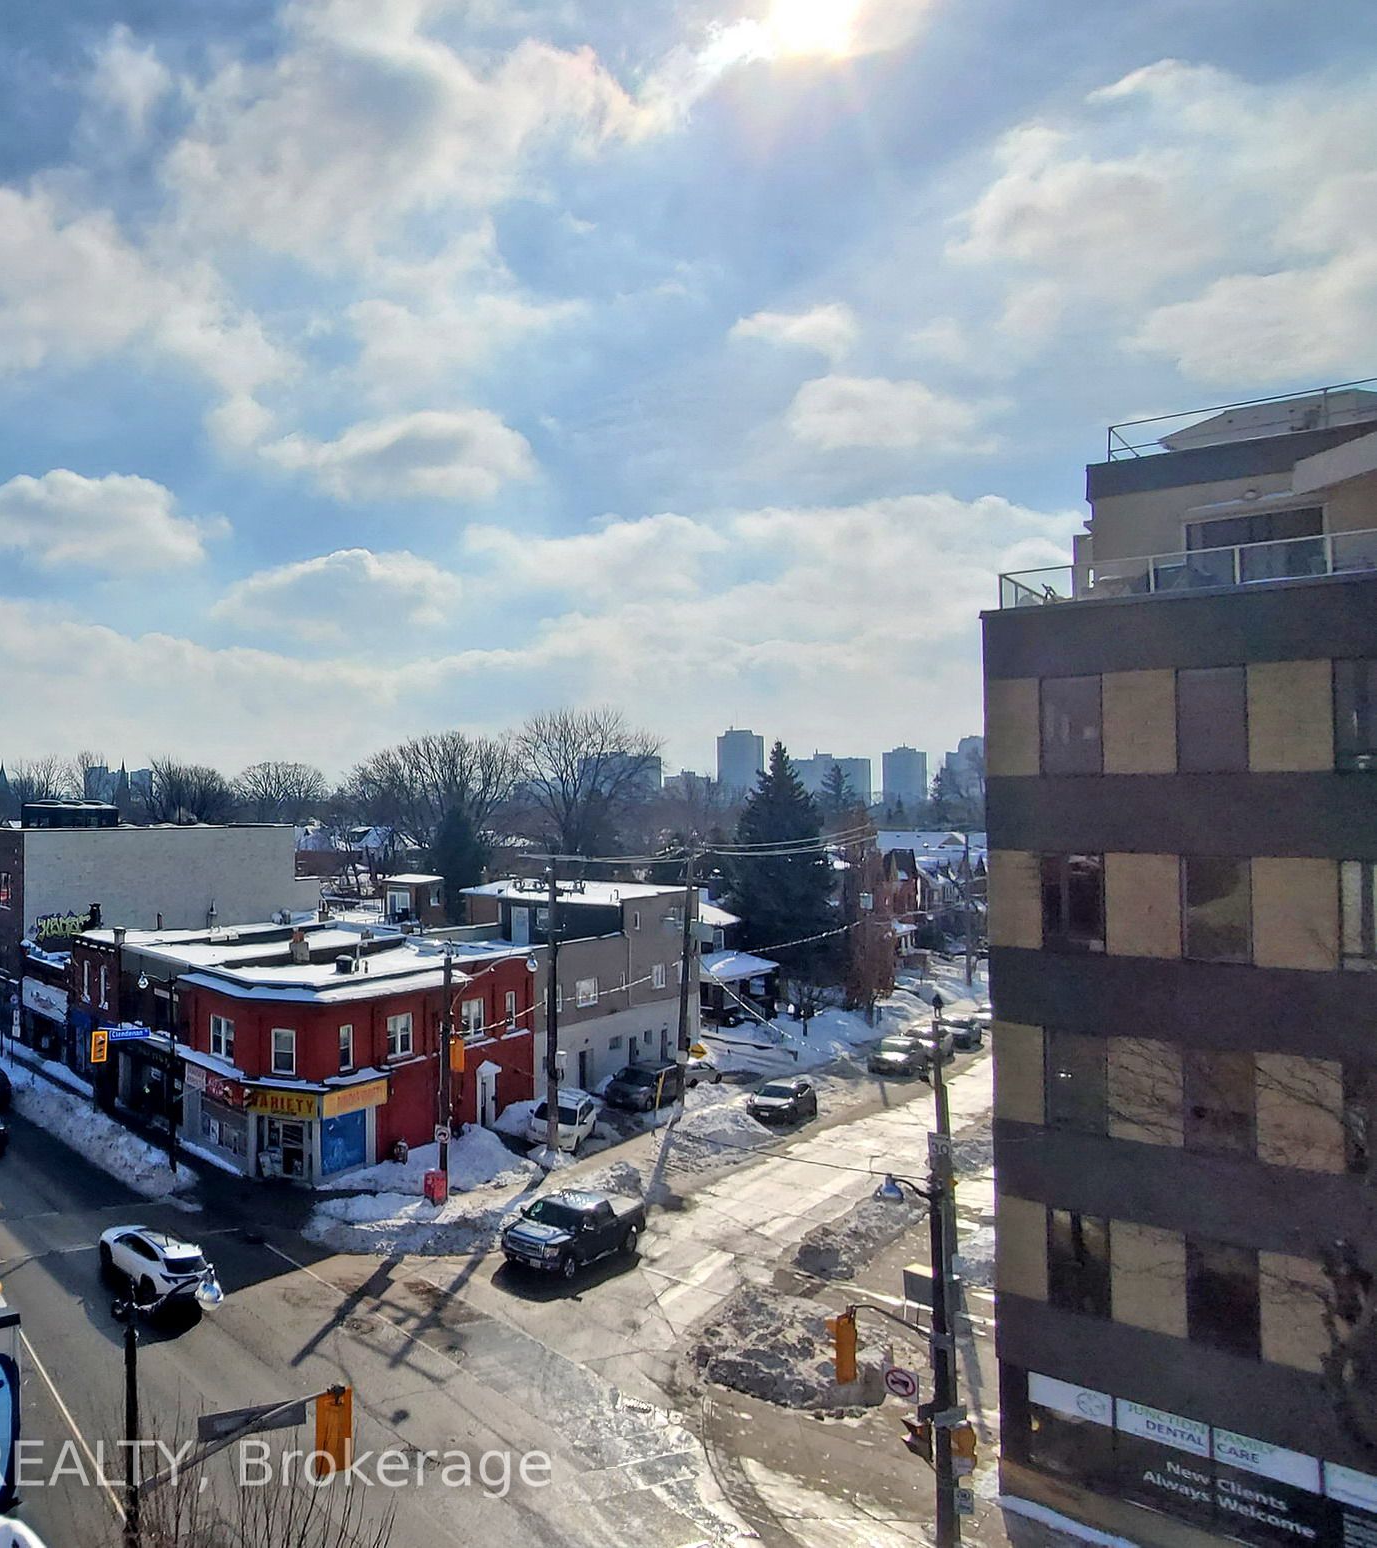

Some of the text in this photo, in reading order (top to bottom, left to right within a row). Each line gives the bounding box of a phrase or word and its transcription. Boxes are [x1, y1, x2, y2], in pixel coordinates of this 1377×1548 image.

[1128, 1404, 1205, 1434] JUNCTION
[1216, 1428, 1277, 1454] FAMILY
[1146, 1420, 1204, 1446] DENTAL
[1217, 1442, 1260, 1463] CARE
[1143, 1470, 1212, 1502] Always
[1217, 1494, 1317, 1539] Welcome
[1166, 1461, 1210, 1485] New
[1217, 1479, 1288, 1512] Clients
